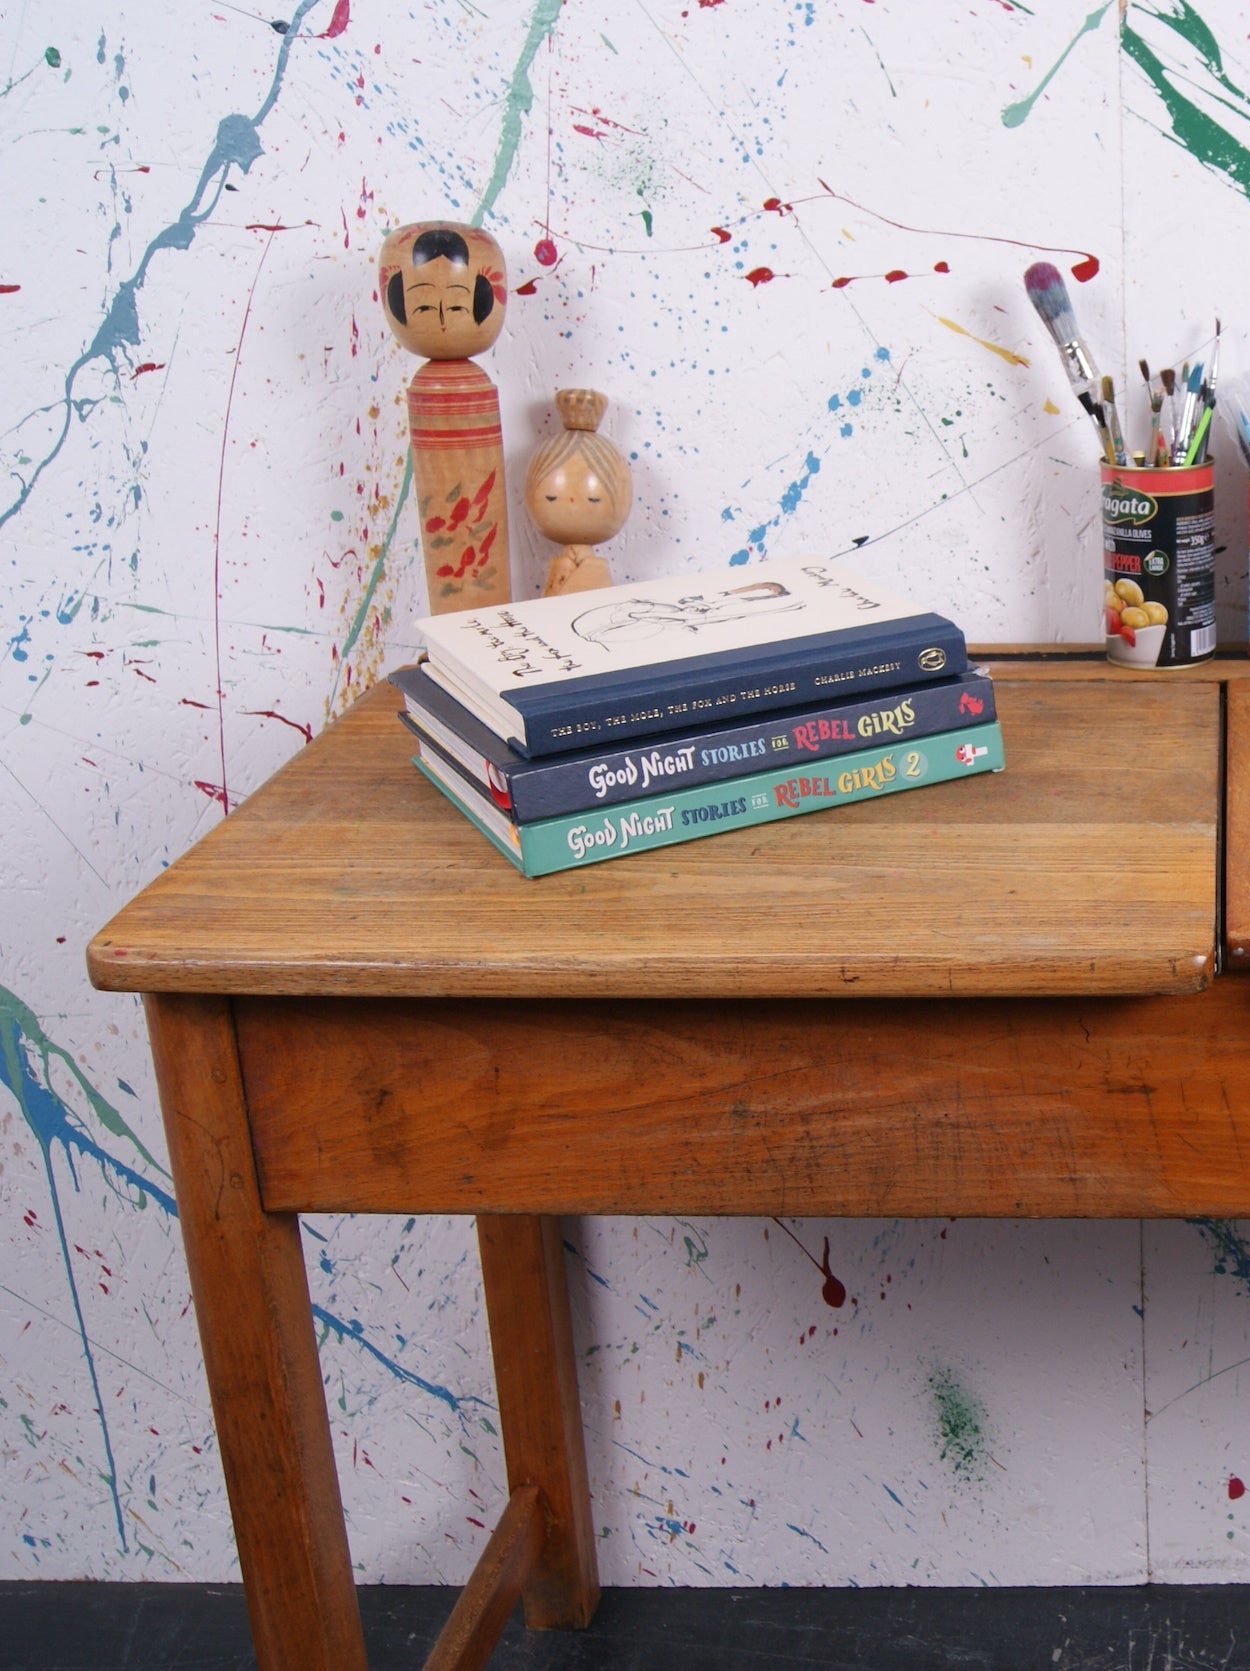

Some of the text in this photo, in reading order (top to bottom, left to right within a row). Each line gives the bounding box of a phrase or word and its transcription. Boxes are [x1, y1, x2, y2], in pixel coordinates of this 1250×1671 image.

[814, 662, 901, 686] CHARLIE MACKESY
[551, 723, 573, 738] THE
[605, 715, 627, 727] THE
[631, 708, 664, 722] MOLE,
[667, 703, 688, 715] THE
[692, 699, 712, 710] FOX
[715, 693, 737, 706] AND
[740, 688, 761, 700] THE
[764, 682, 796, 696] HORSE
[701, 737, 767, 767] STORIES
[772, 736, 789, 750] FOR
[792, 718, 856, 752] REBEL
[681, 797, 747, 826] STORIES
[752, 794, 769, 808] FOR
[773, 777, 836, 808] REBEL
[906, 752, 921, 777] 2
